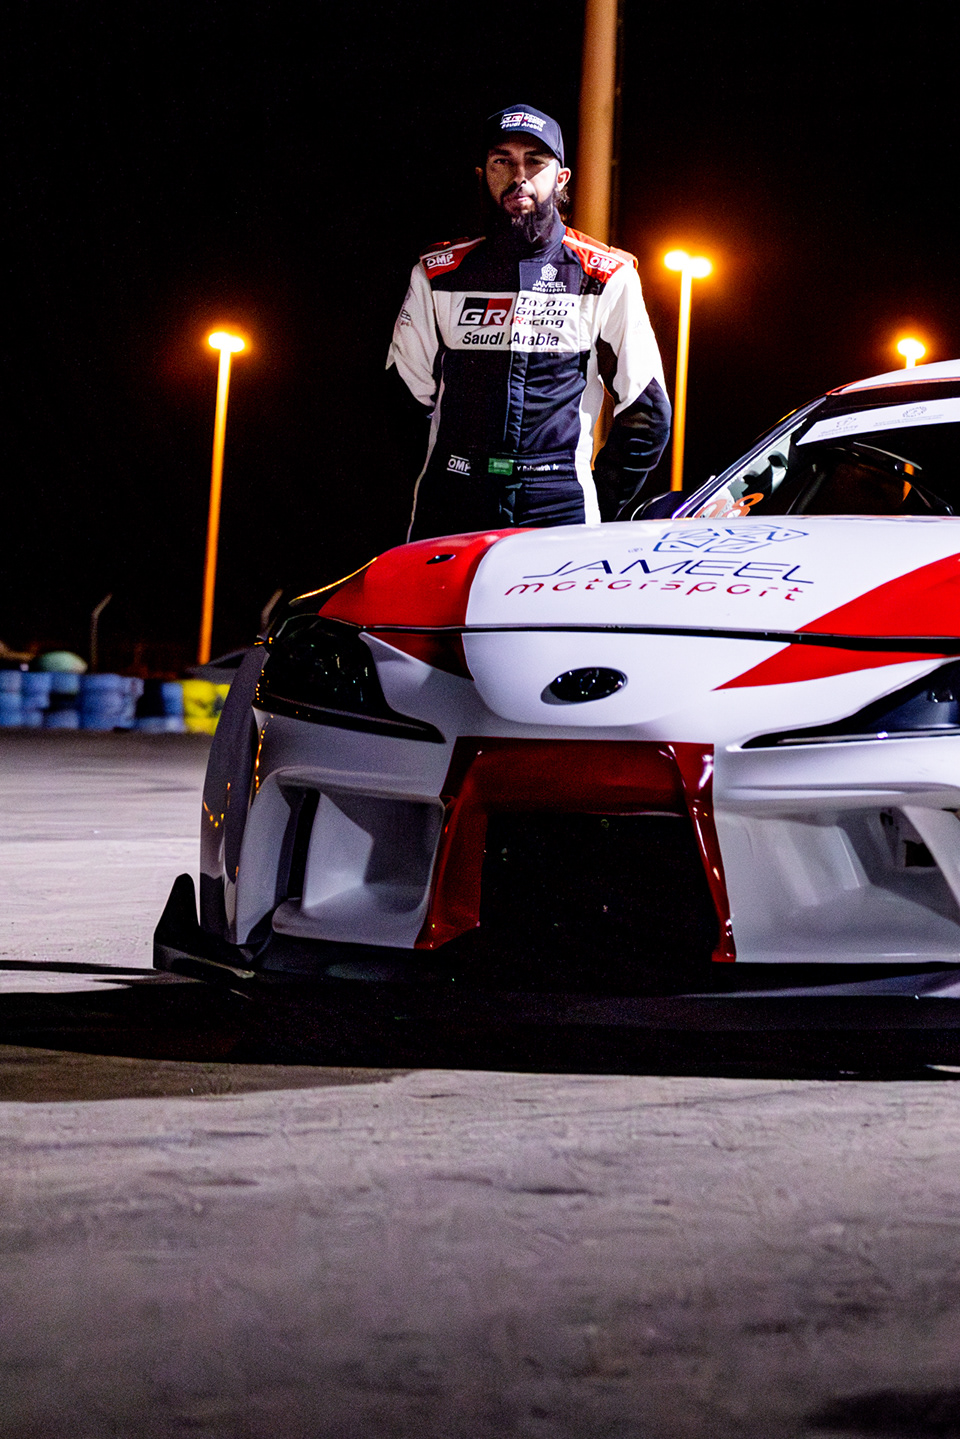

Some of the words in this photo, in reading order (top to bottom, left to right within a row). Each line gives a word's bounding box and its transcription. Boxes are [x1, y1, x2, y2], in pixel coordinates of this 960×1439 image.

[427, 253, 454, 266] OMP
[590, 254, 616, 271] OMP
[533, 280, 567, 288] JAMEEL
[460, 308, 508, 325] GR
[462, 332, 505, 345] Saudi
[507, 332, 560, 346] Arabia
[523, 559, 814, 584] JAMEEL
[504, 578, 804, 601] motorsport
